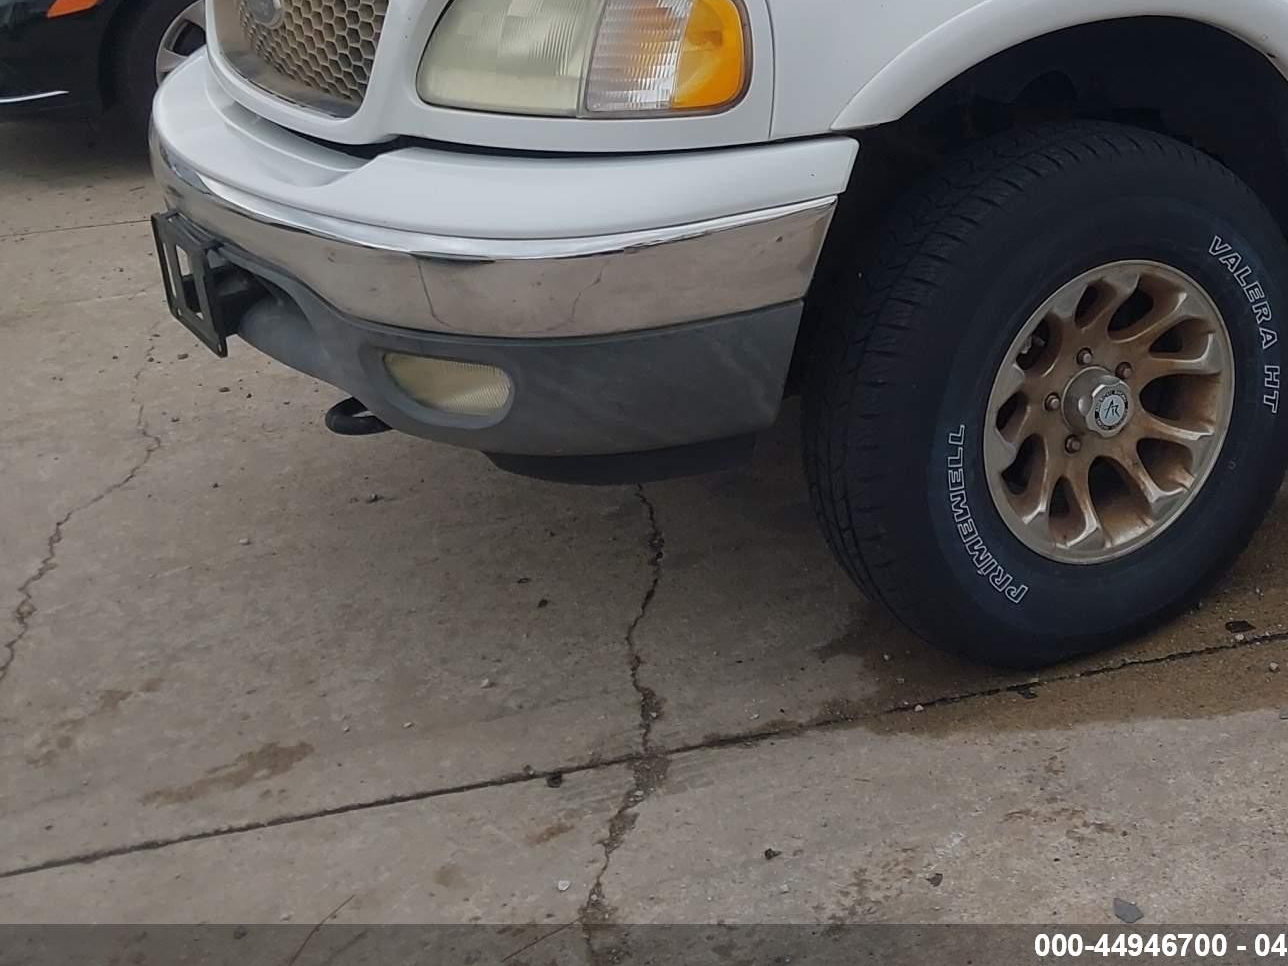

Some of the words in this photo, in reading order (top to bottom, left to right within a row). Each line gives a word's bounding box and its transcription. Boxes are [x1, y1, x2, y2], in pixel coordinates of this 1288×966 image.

[1208, 235, 1278, 350] VALERA
[1264, 365, 1280, 414] HT
[948, 424, 1029, 604] PRIMEWELL
